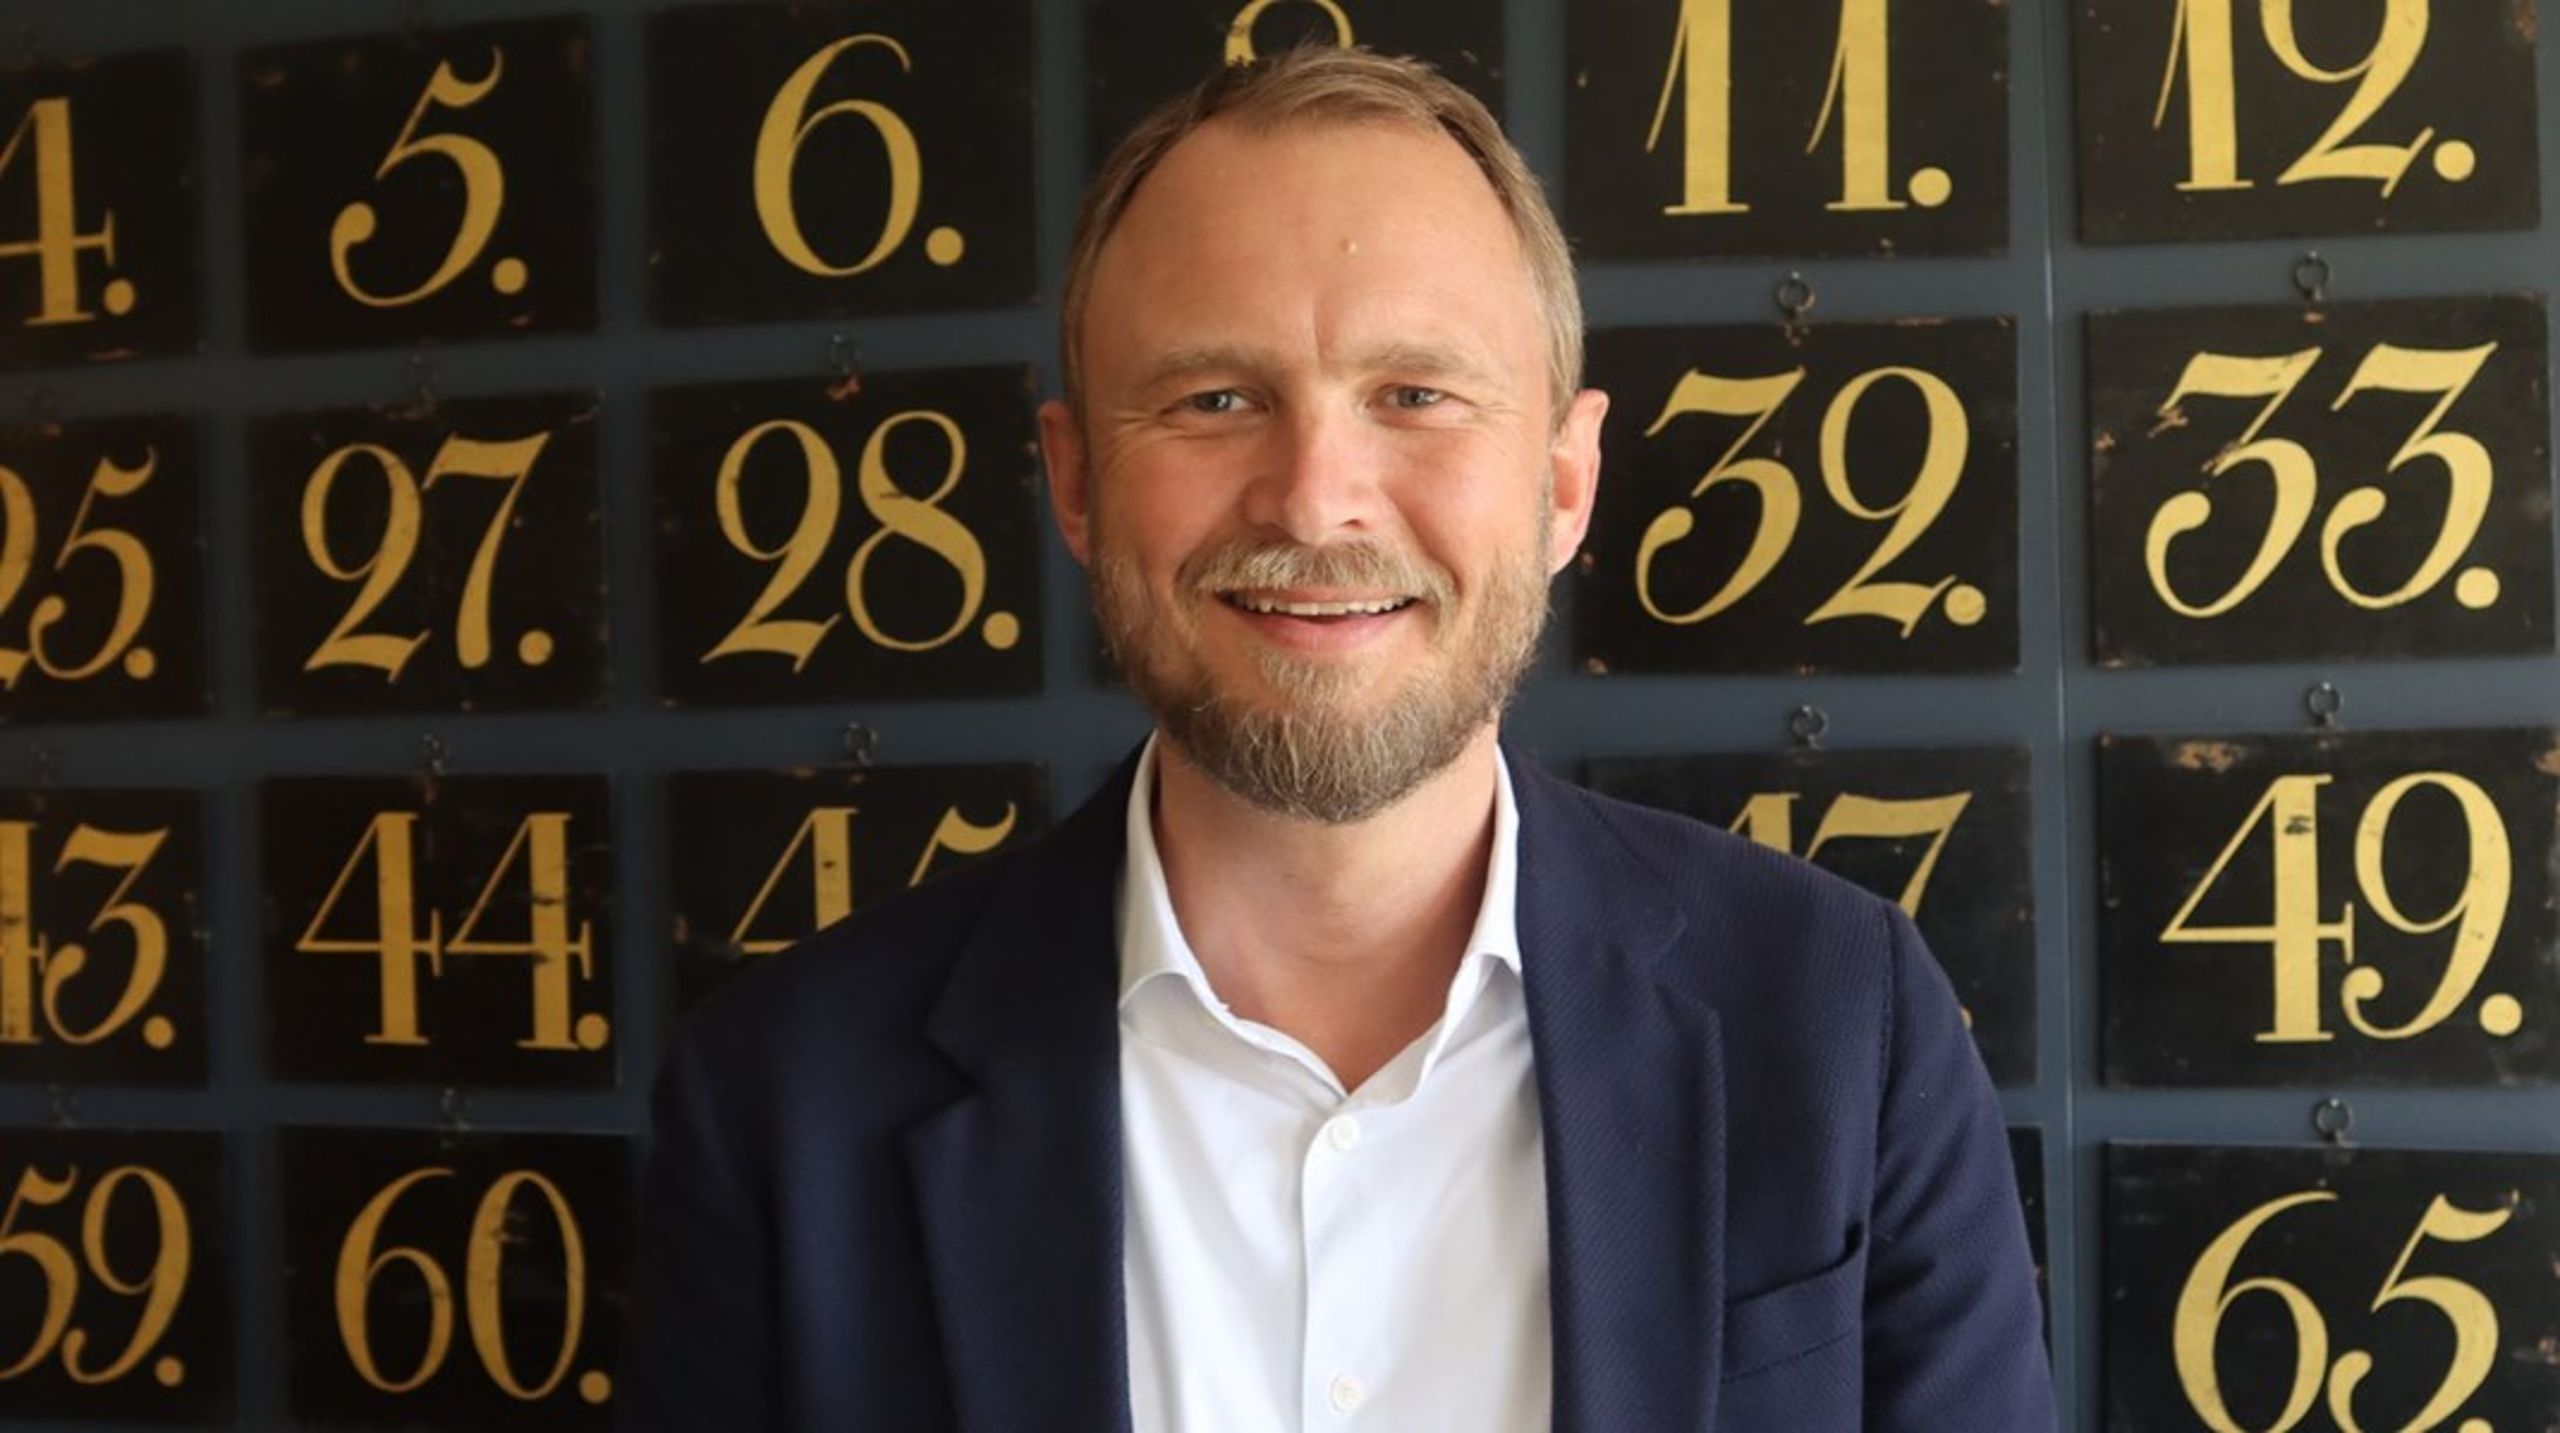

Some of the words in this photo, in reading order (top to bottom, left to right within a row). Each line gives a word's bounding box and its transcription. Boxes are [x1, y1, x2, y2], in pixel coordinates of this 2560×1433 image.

[0, 97, 137, 326] 4.
[329, 46, 528, 307] 5.
[753, 33, 965, 276] 6.
[1645, 0, 1953, 215] 11.
[2153, 0, 2477, 199] 12.
[303, 432, 555, 685] 27.
[700, 409, 1020, 675] 28.
[1635, 366, 1988, 639] 32.
[2145, 341, 2501, 619] 33.
[295, 811, 611, 1052] 44.
[2159, 771, 2523, 1043] 49.
[335, 1167, 612, 1404] 60.
